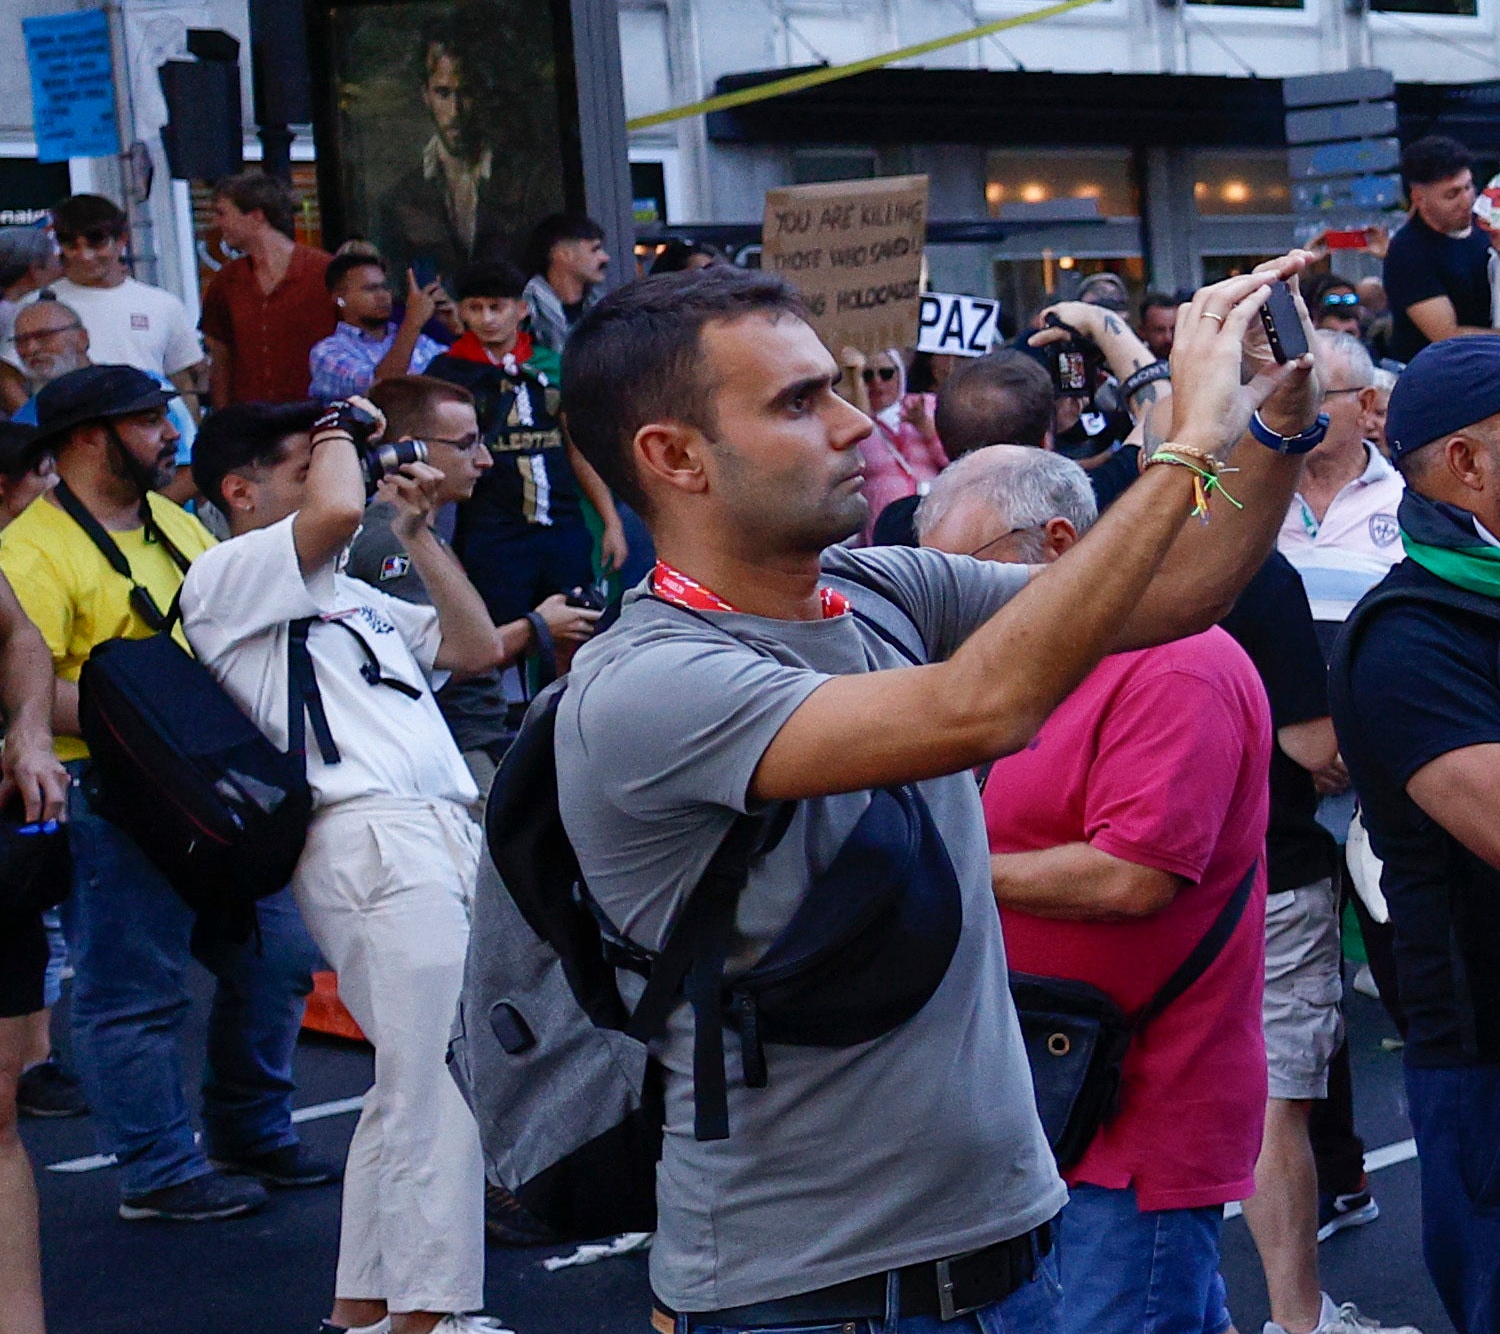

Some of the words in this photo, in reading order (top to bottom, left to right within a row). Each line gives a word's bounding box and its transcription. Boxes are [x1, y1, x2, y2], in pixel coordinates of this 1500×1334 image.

[775, 211, 811, 235] YOU
[819, 203, 855, 230] ARE
[919, 298, 994, 351] PAZ
